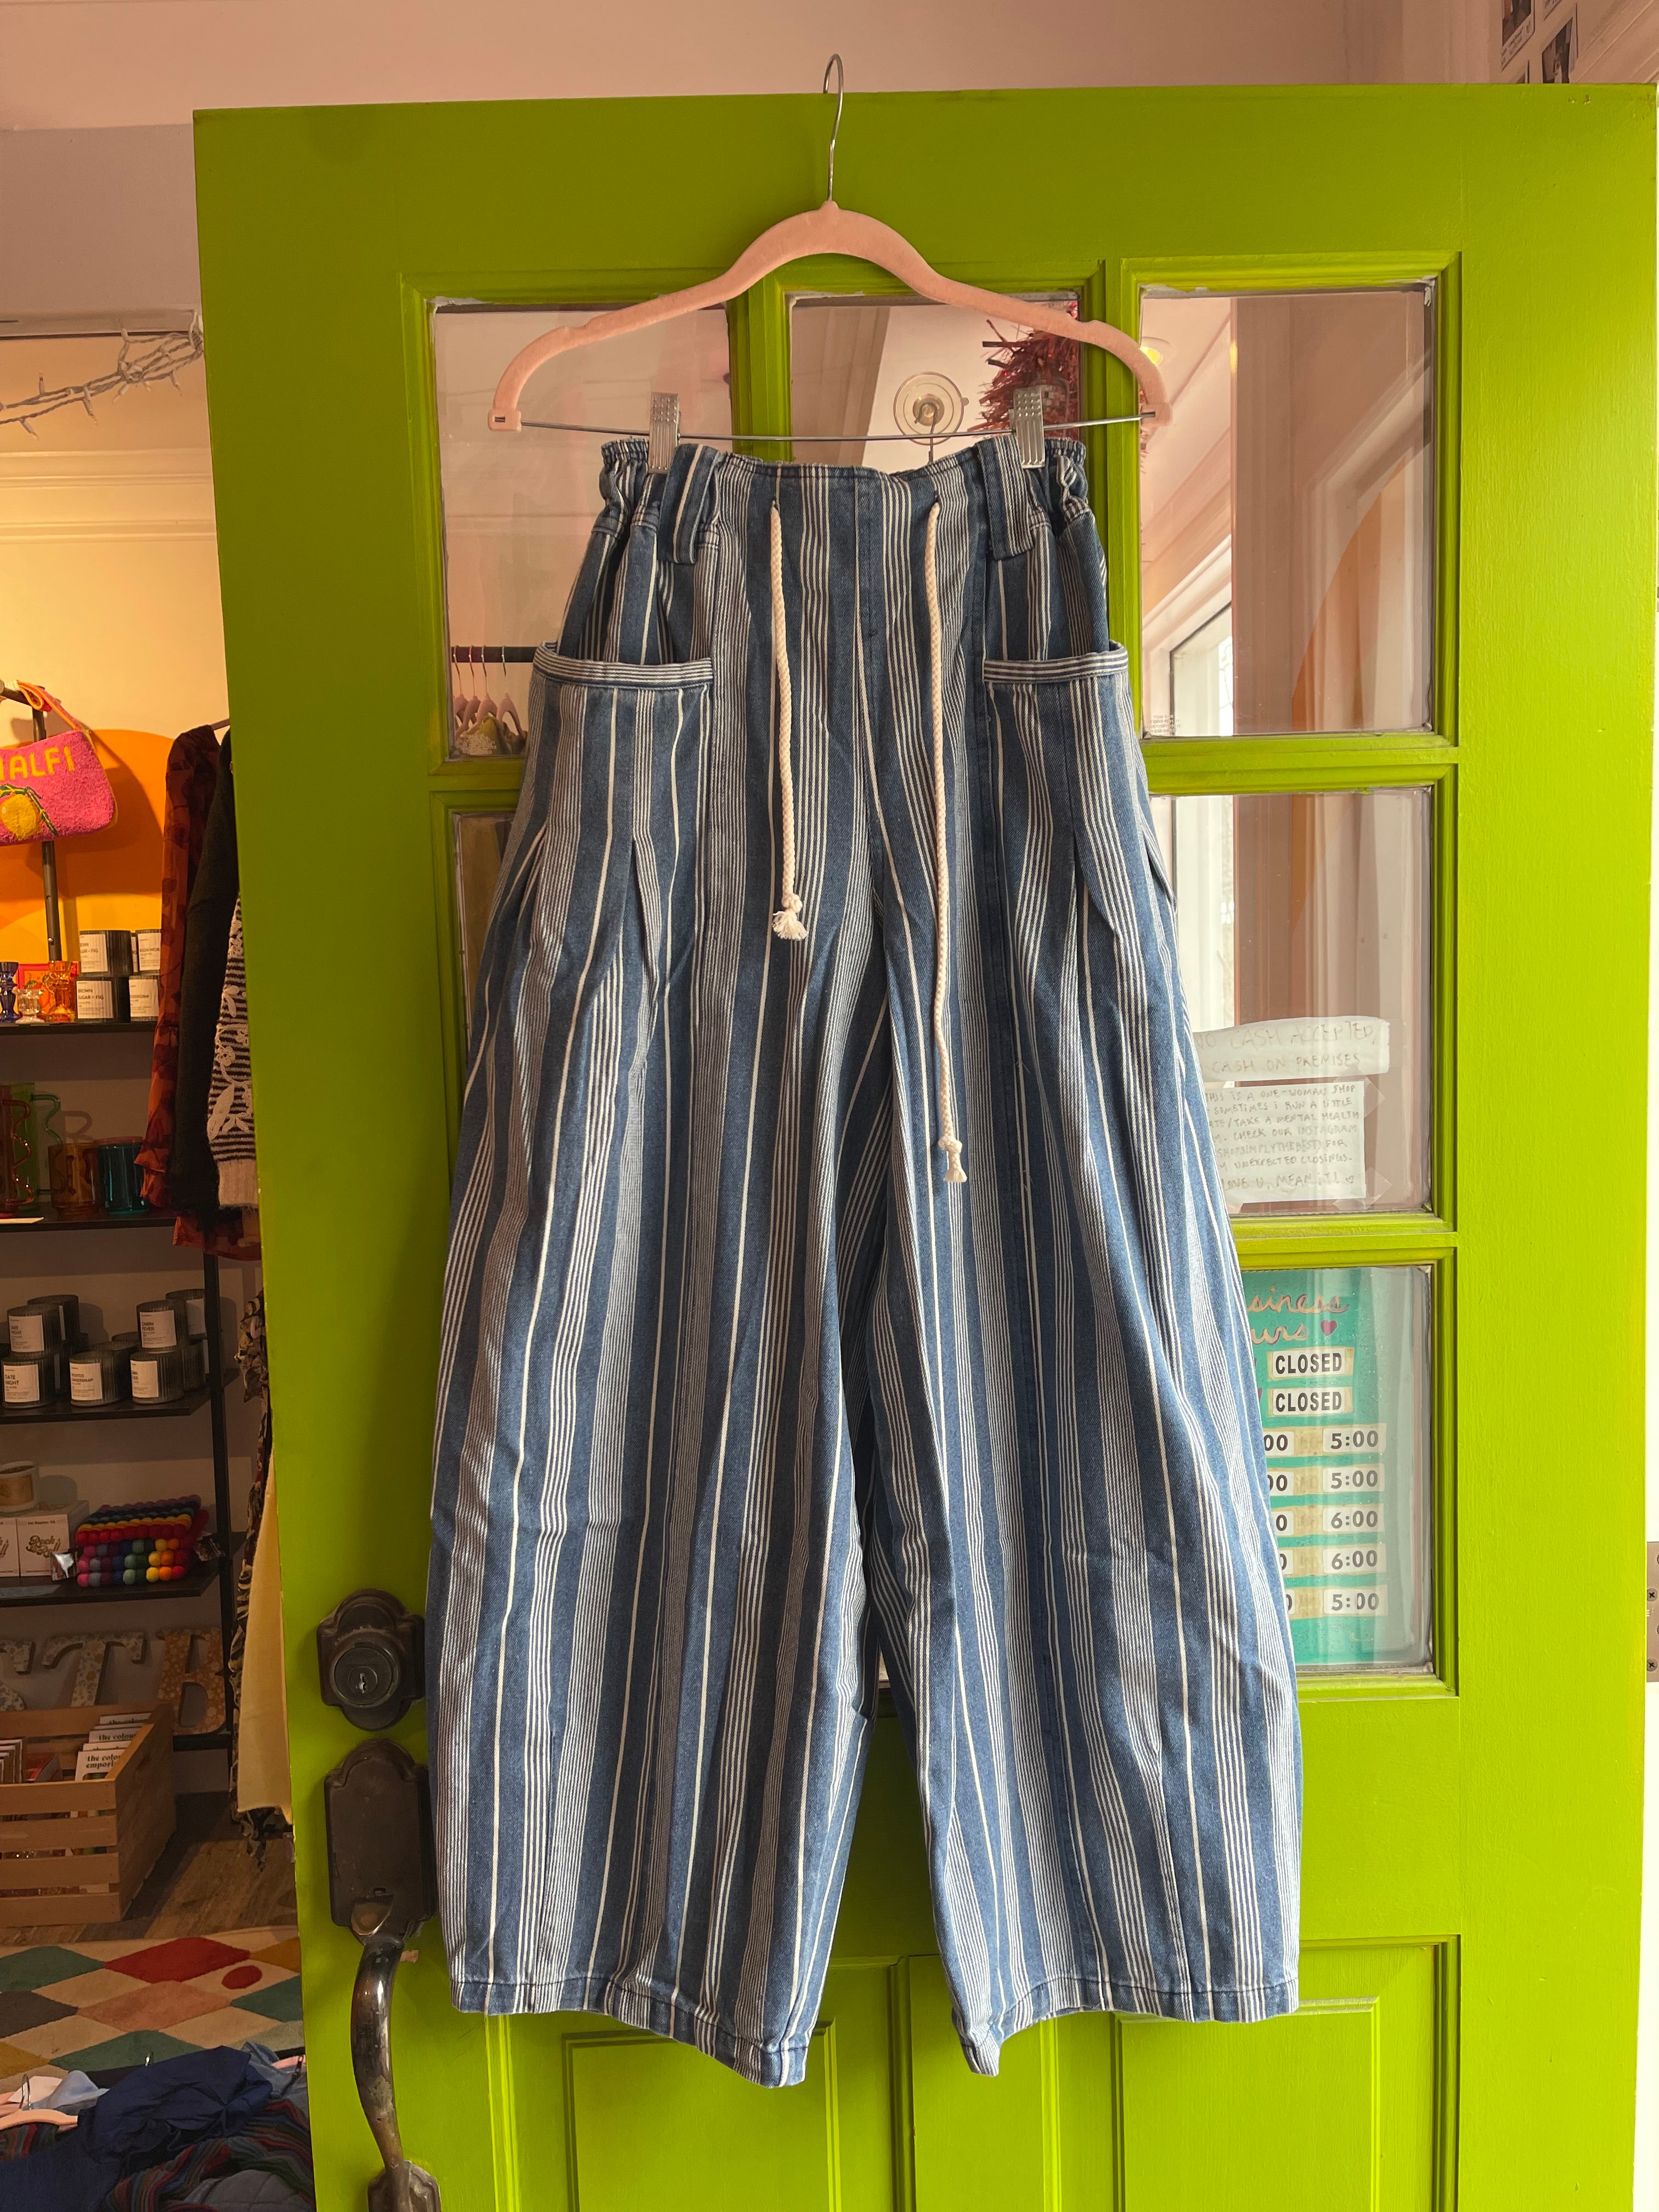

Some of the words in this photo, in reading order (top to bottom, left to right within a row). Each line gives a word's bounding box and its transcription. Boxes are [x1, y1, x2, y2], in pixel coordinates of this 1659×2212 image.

[0, 746, 75, 781] ALFI
[1231, 1028, 1283, 1050] CASH
[1212, 1059, 1258, 1073] CASH
[1267, 1056, 1286, 1070] ON
[1296, 1053, 1361, 1073] PREMISES
[1247, 1092, 1255, 1102] A
[1332, 1084, 1356, 1094] SHOP
[1285, 1101, 1305, 1110] RUN
[1310, 1101, 1317, 1109] A
[1265, 1116, 1272, 1124] A
[1277, 1114, 1318, 1123] MENTAL
[1322, 1110, 1359, 1121] HEALTH
[1233, 1128, 1266, 1141] CHECK
[1272, 1127, 1293, 1136] OUR
[1297, 1124, 1358, 1136] INSTAGRAM
[1325, 1139, 1348, 1148] FOR
[1234, 1155, 1297, 1169] UNEXPECTED
[1221, 1178, 1250, 1191] LOVE
[1276, 1173, 1312, 1187] MEAN
[1276, 1352, 1342, 1375] CLOSED
[1276, 1391, 1342, 1413] CLOSED
[1330, 1430, 1379, 1449] 5:00
[1330, 1470, 1378, 1489] 5:00
[1331, 1510, 1378, 1529] 6:00
[1331, 1550, 1378, 1570] 6:00
[1331, 1593, 1379, 1611] 5:00
